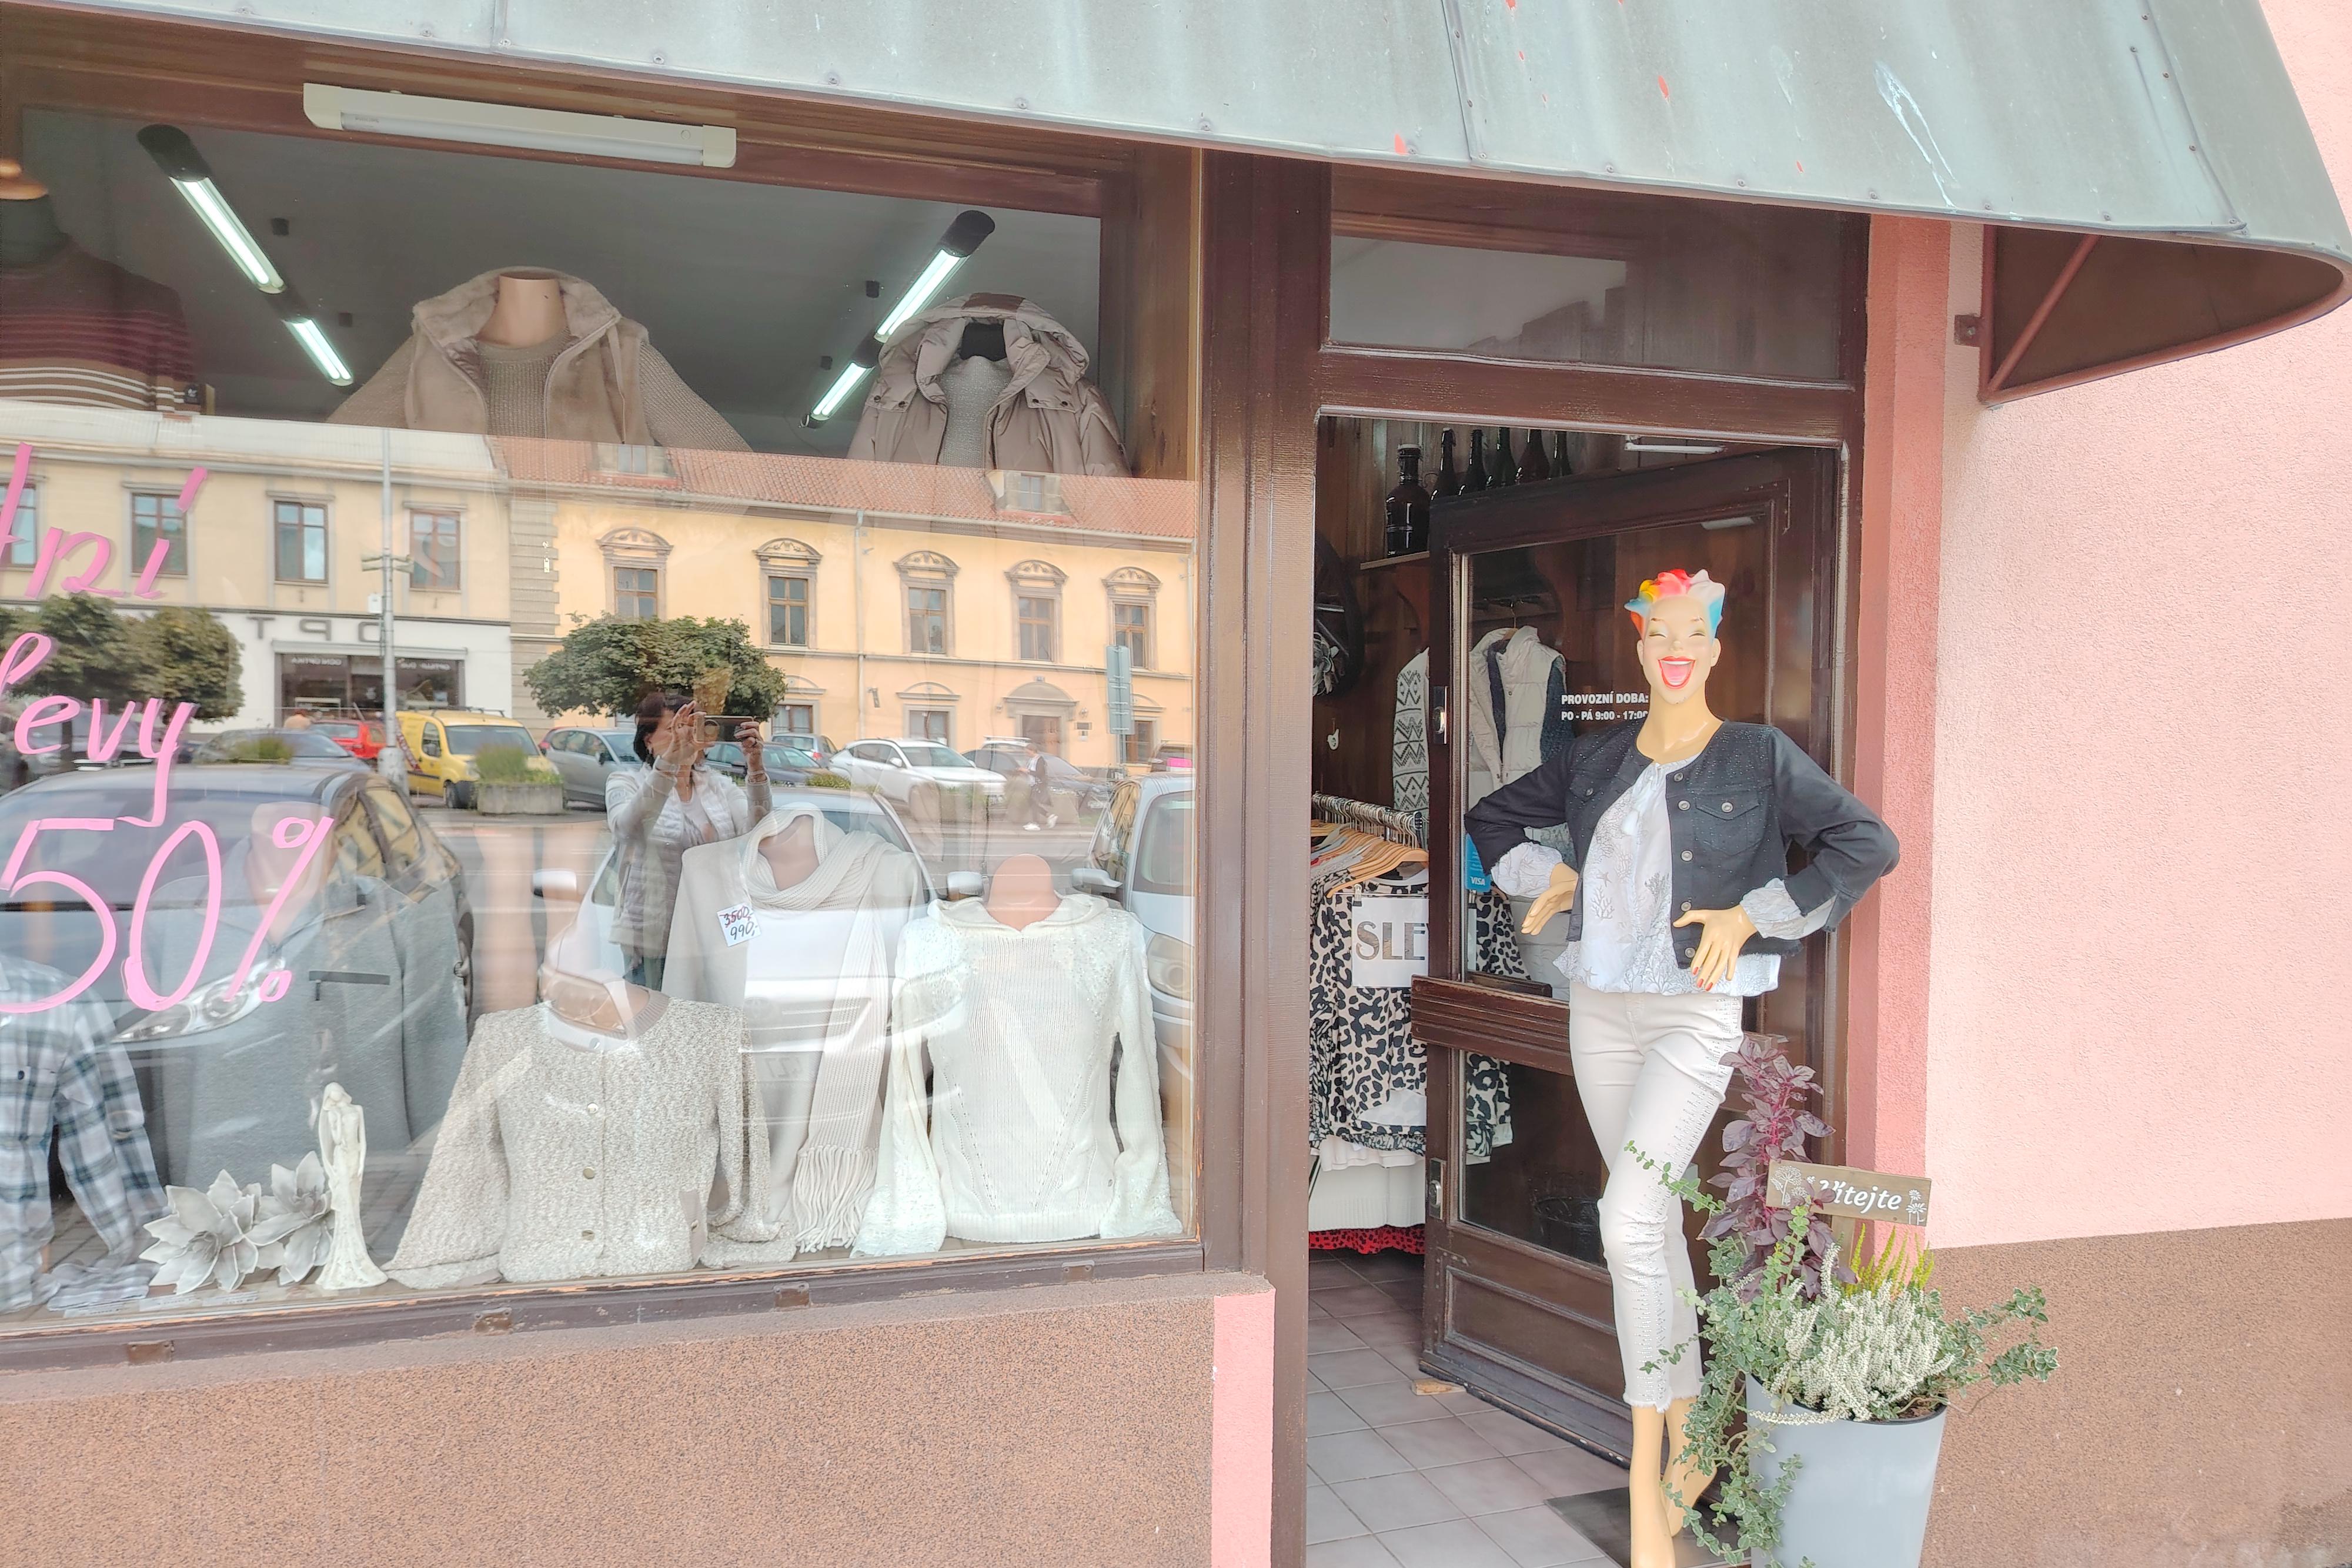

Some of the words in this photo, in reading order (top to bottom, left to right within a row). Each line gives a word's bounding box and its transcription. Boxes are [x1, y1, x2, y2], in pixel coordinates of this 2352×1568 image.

[1561, 691, 1614, 704] PROVOZNÍ
[1616, 693, 1649, 703] DOBA:
[1561, 711, 1574, 721] PO
[1581, 709, 1593, 720] PÁ
[1595, 711, 1615, 720] 9:00
[1470, 876, 1486, 886] VISA
[0, 815, 334, 1014] 50%
